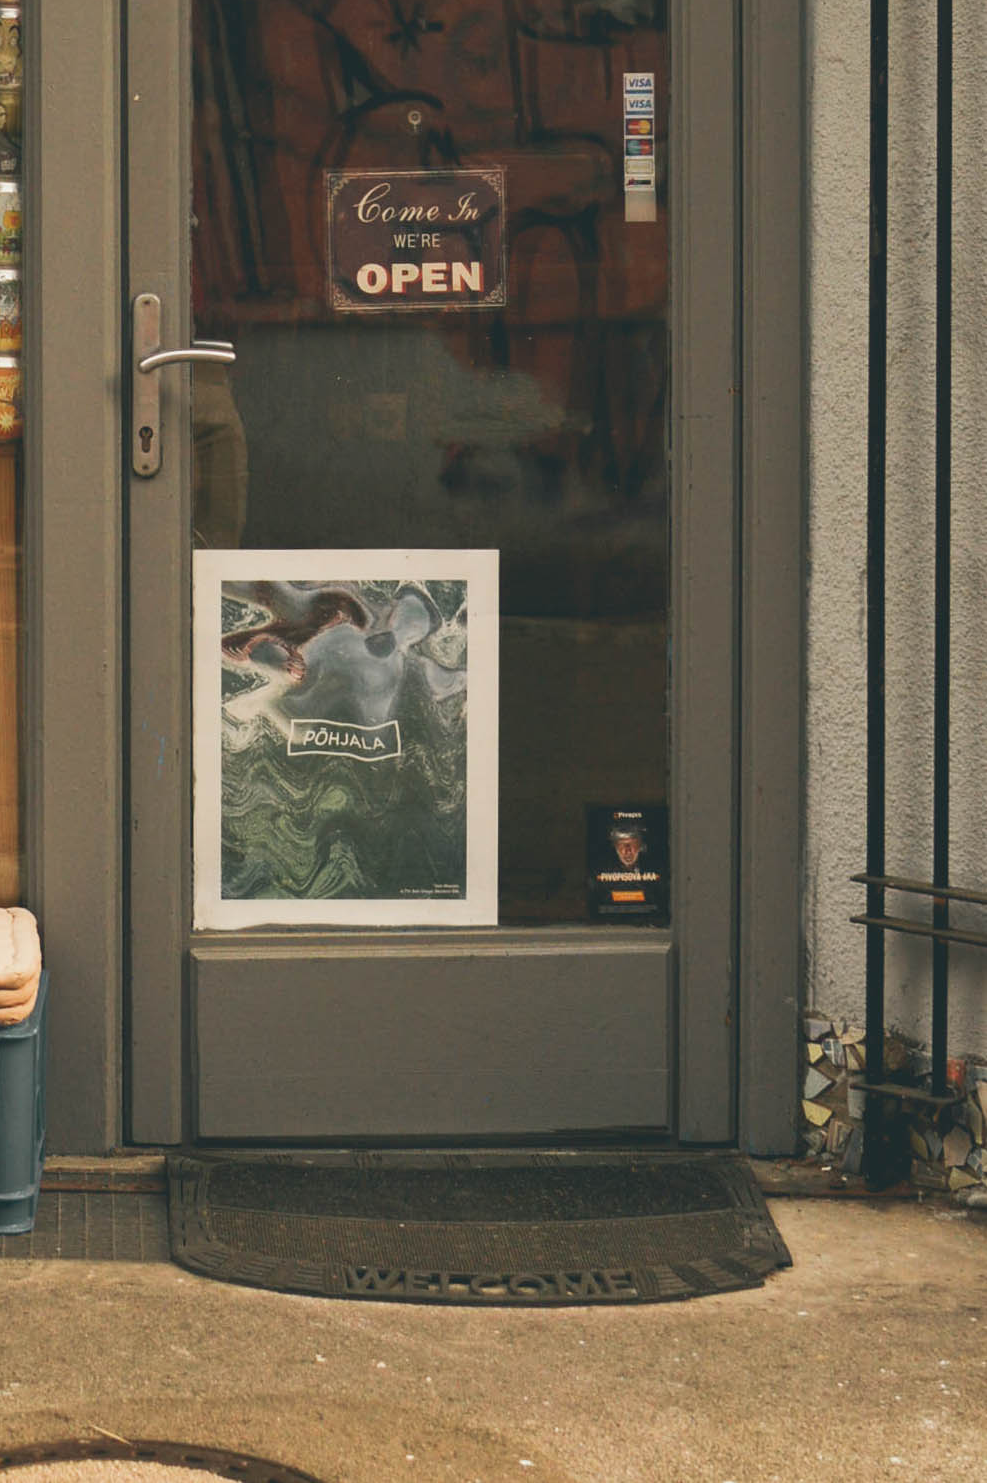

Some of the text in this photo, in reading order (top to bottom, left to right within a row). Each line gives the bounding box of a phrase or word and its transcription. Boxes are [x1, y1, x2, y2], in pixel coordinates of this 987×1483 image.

[628, 77, 653, 89] VISA
[628, 98, 653, 109] VISA
[352, 181, 481, 224] Come In
[393, 232, 441, 249] WE'RE
[356, 261, 485, 295] OPEN
[344, 1267, 634, 1296] WELCOME
